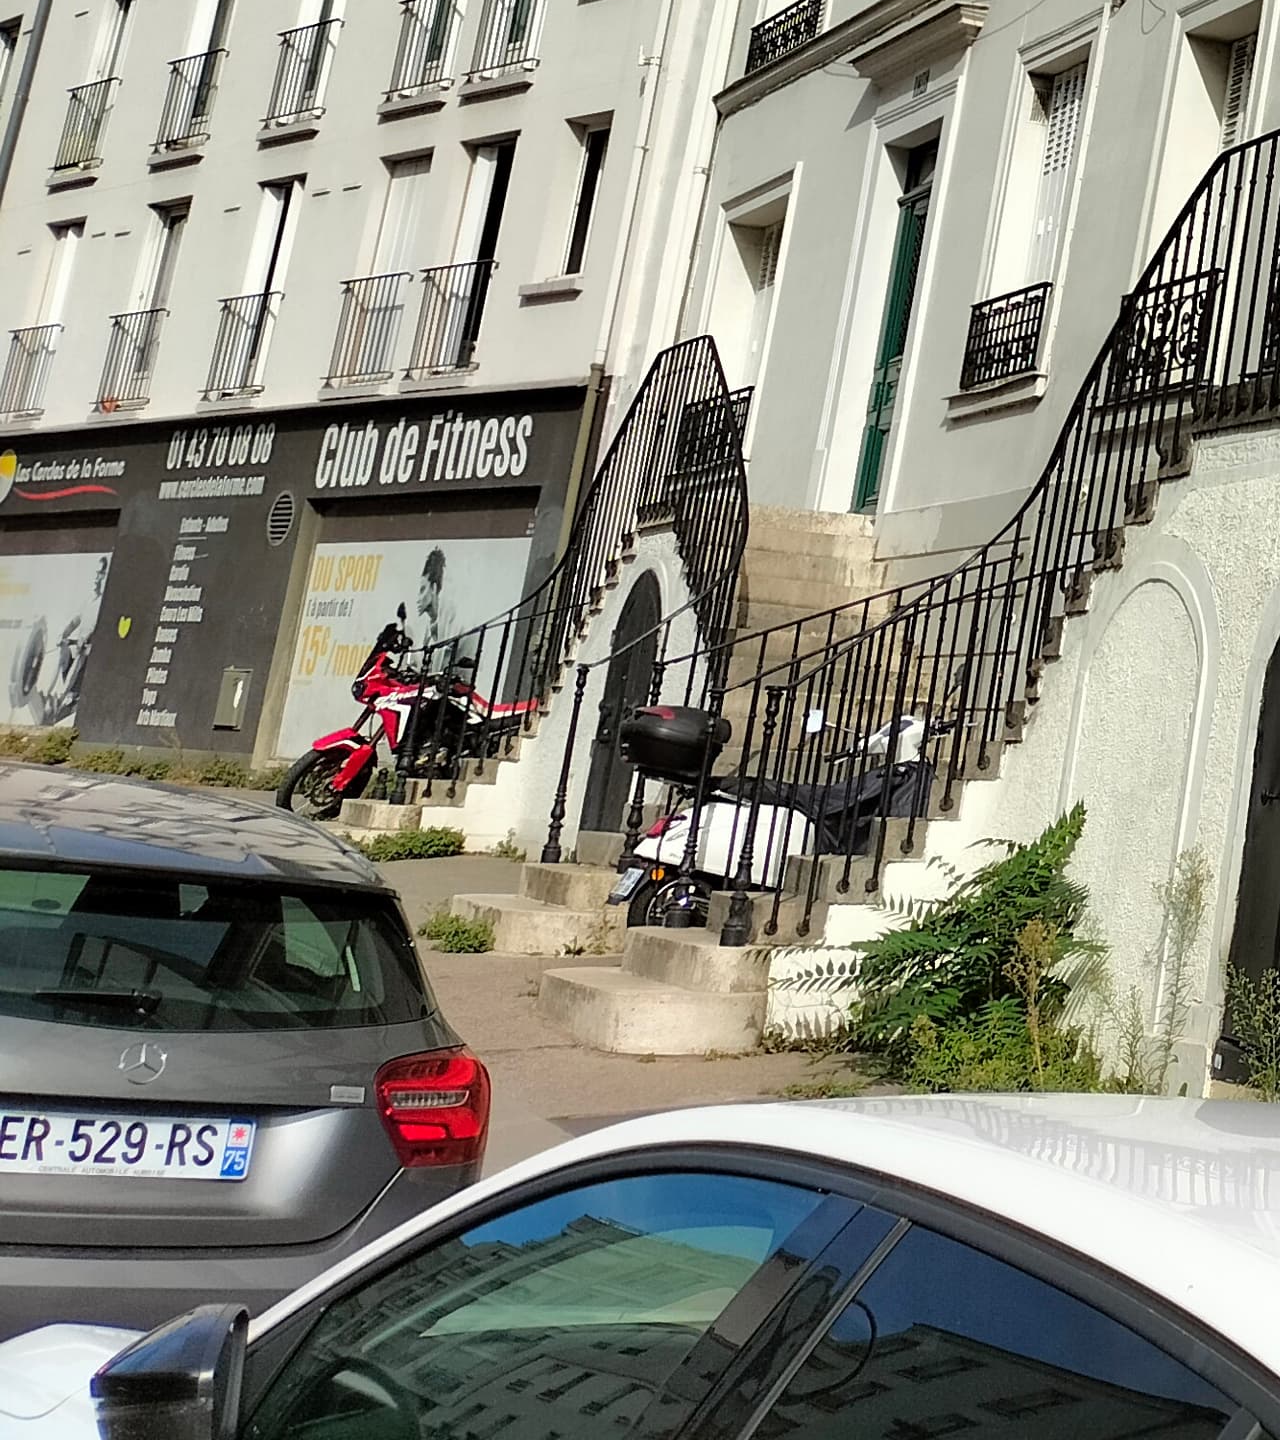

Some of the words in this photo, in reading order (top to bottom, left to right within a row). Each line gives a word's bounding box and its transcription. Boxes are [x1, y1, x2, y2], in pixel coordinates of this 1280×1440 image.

[166, 430, 187, 470] 01
[185, 428, 209, 468] 43
[205, 426, 230, 467] 70
[227, 424, 253, 466] 08
[250, 422, 276, 465] 08
[315, 423, 379, 489] Club
[379, 417, 420, 485] de
[418, 409, 533, 482] Fitness
[65, 459, 81, 479] de
[80, 458, 92, 478] la
[92, 457, 125, 478] Forme
[312, 555, 335, 592] DU
[334, 554, 384, 592] SPORT
[0, 1116, 218, 1167] ER-529-RS
[222, 1150, 246, 1172] 75
